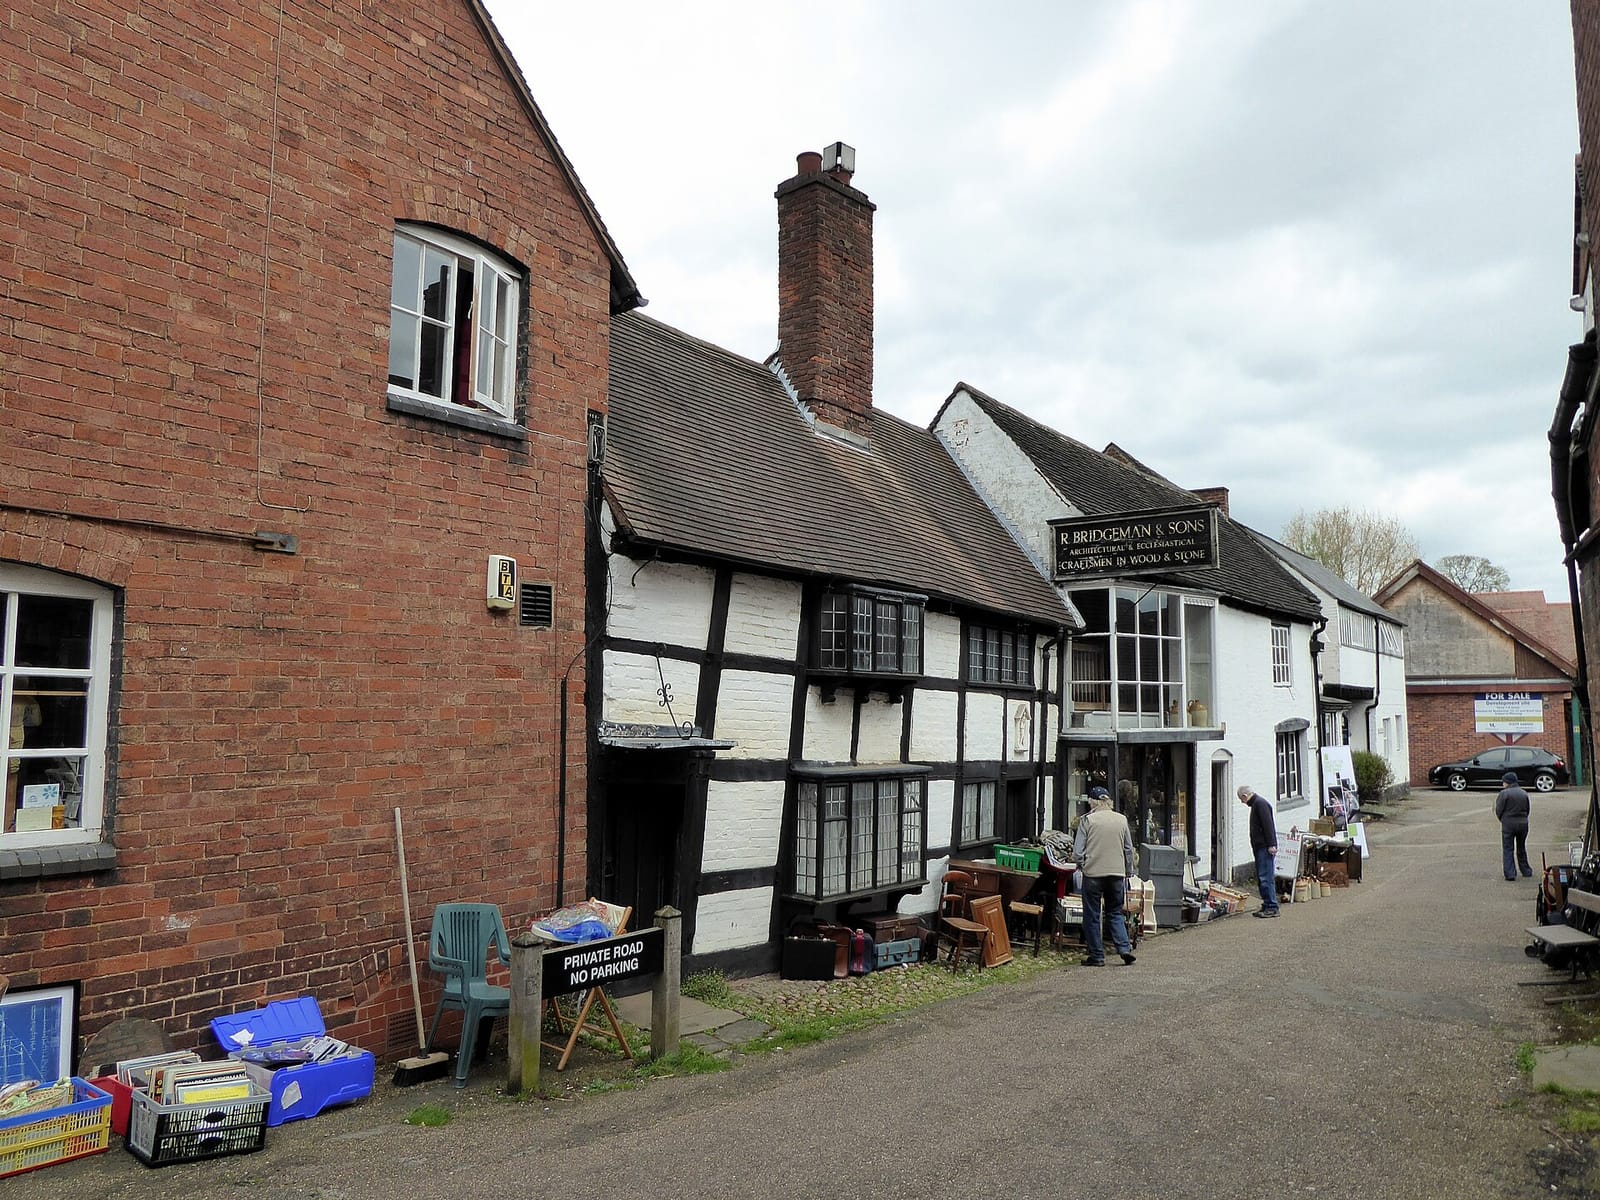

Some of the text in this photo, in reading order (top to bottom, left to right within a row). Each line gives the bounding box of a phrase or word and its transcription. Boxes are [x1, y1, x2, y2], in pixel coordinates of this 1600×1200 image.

[1060, 519, 1205, 545] R BRIDGEMAN & SONS
[1069, 538, 1195, 556] ARCHITECTURAL & ECCLESIASTICAL
[1061, 549, 1206, 570] CRAFTSMEN IN WOOD & STONE
[1485, 692, 1530, 700] FOR SALE
[563, 941, 644, 970] PRIVATE ROAD
[570, 958, 639, 986] NO PARKING
